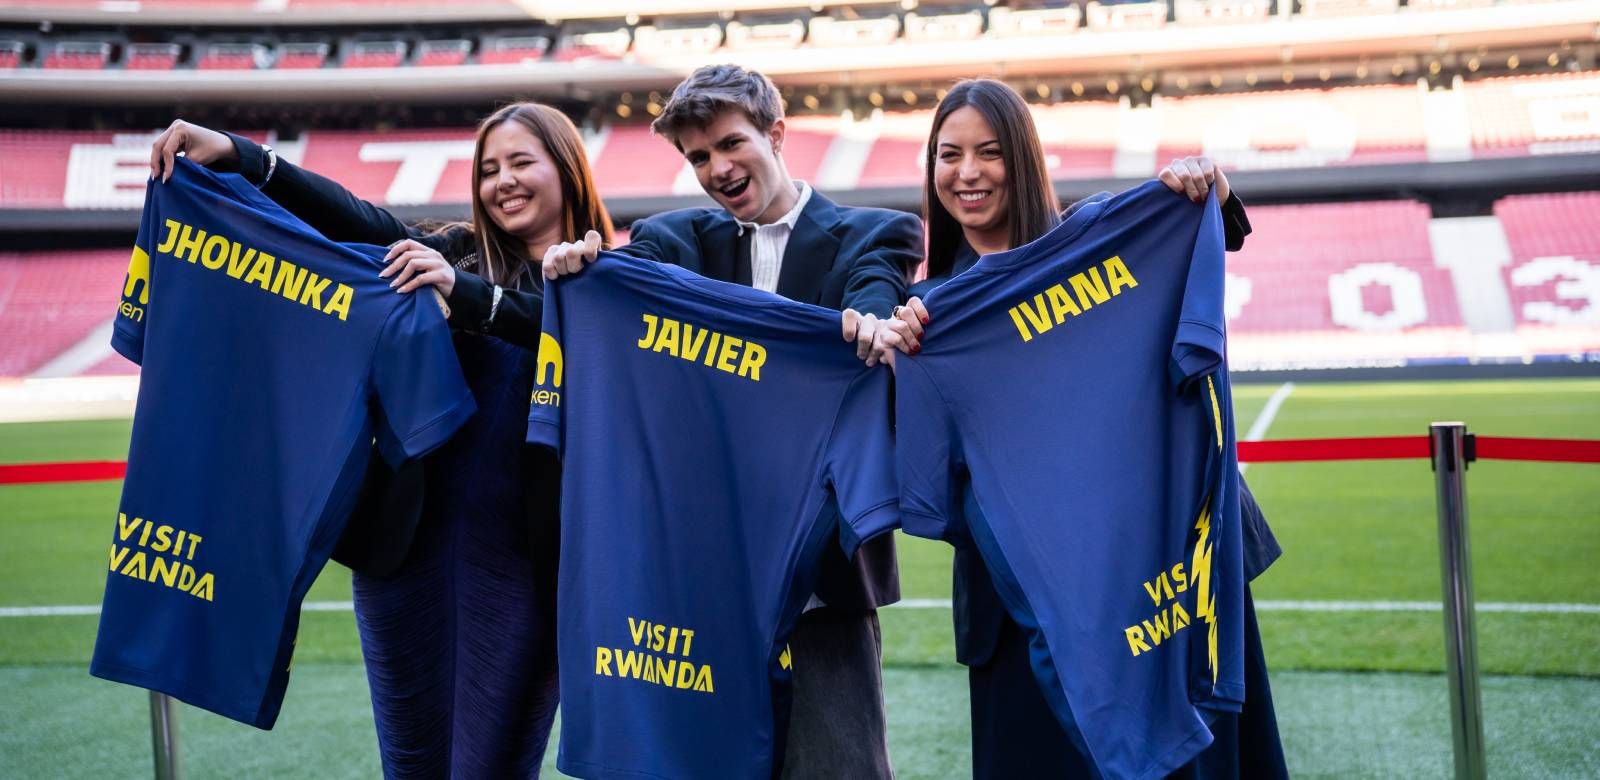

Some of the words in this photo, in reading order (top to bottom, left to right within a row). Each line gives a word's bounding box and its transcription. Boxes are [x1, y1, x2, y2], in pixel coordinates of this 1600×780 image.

[157, 219, 354, 321] JHOVANKA
[1008, 255, 1137, 342] IVANA
[638, 314, 767, 381] JAVIER
[119, 512, 202, 561] VISIT
[628, 617, 694, 657] VISIT
[596, 646, 714, 693] RWANDA
